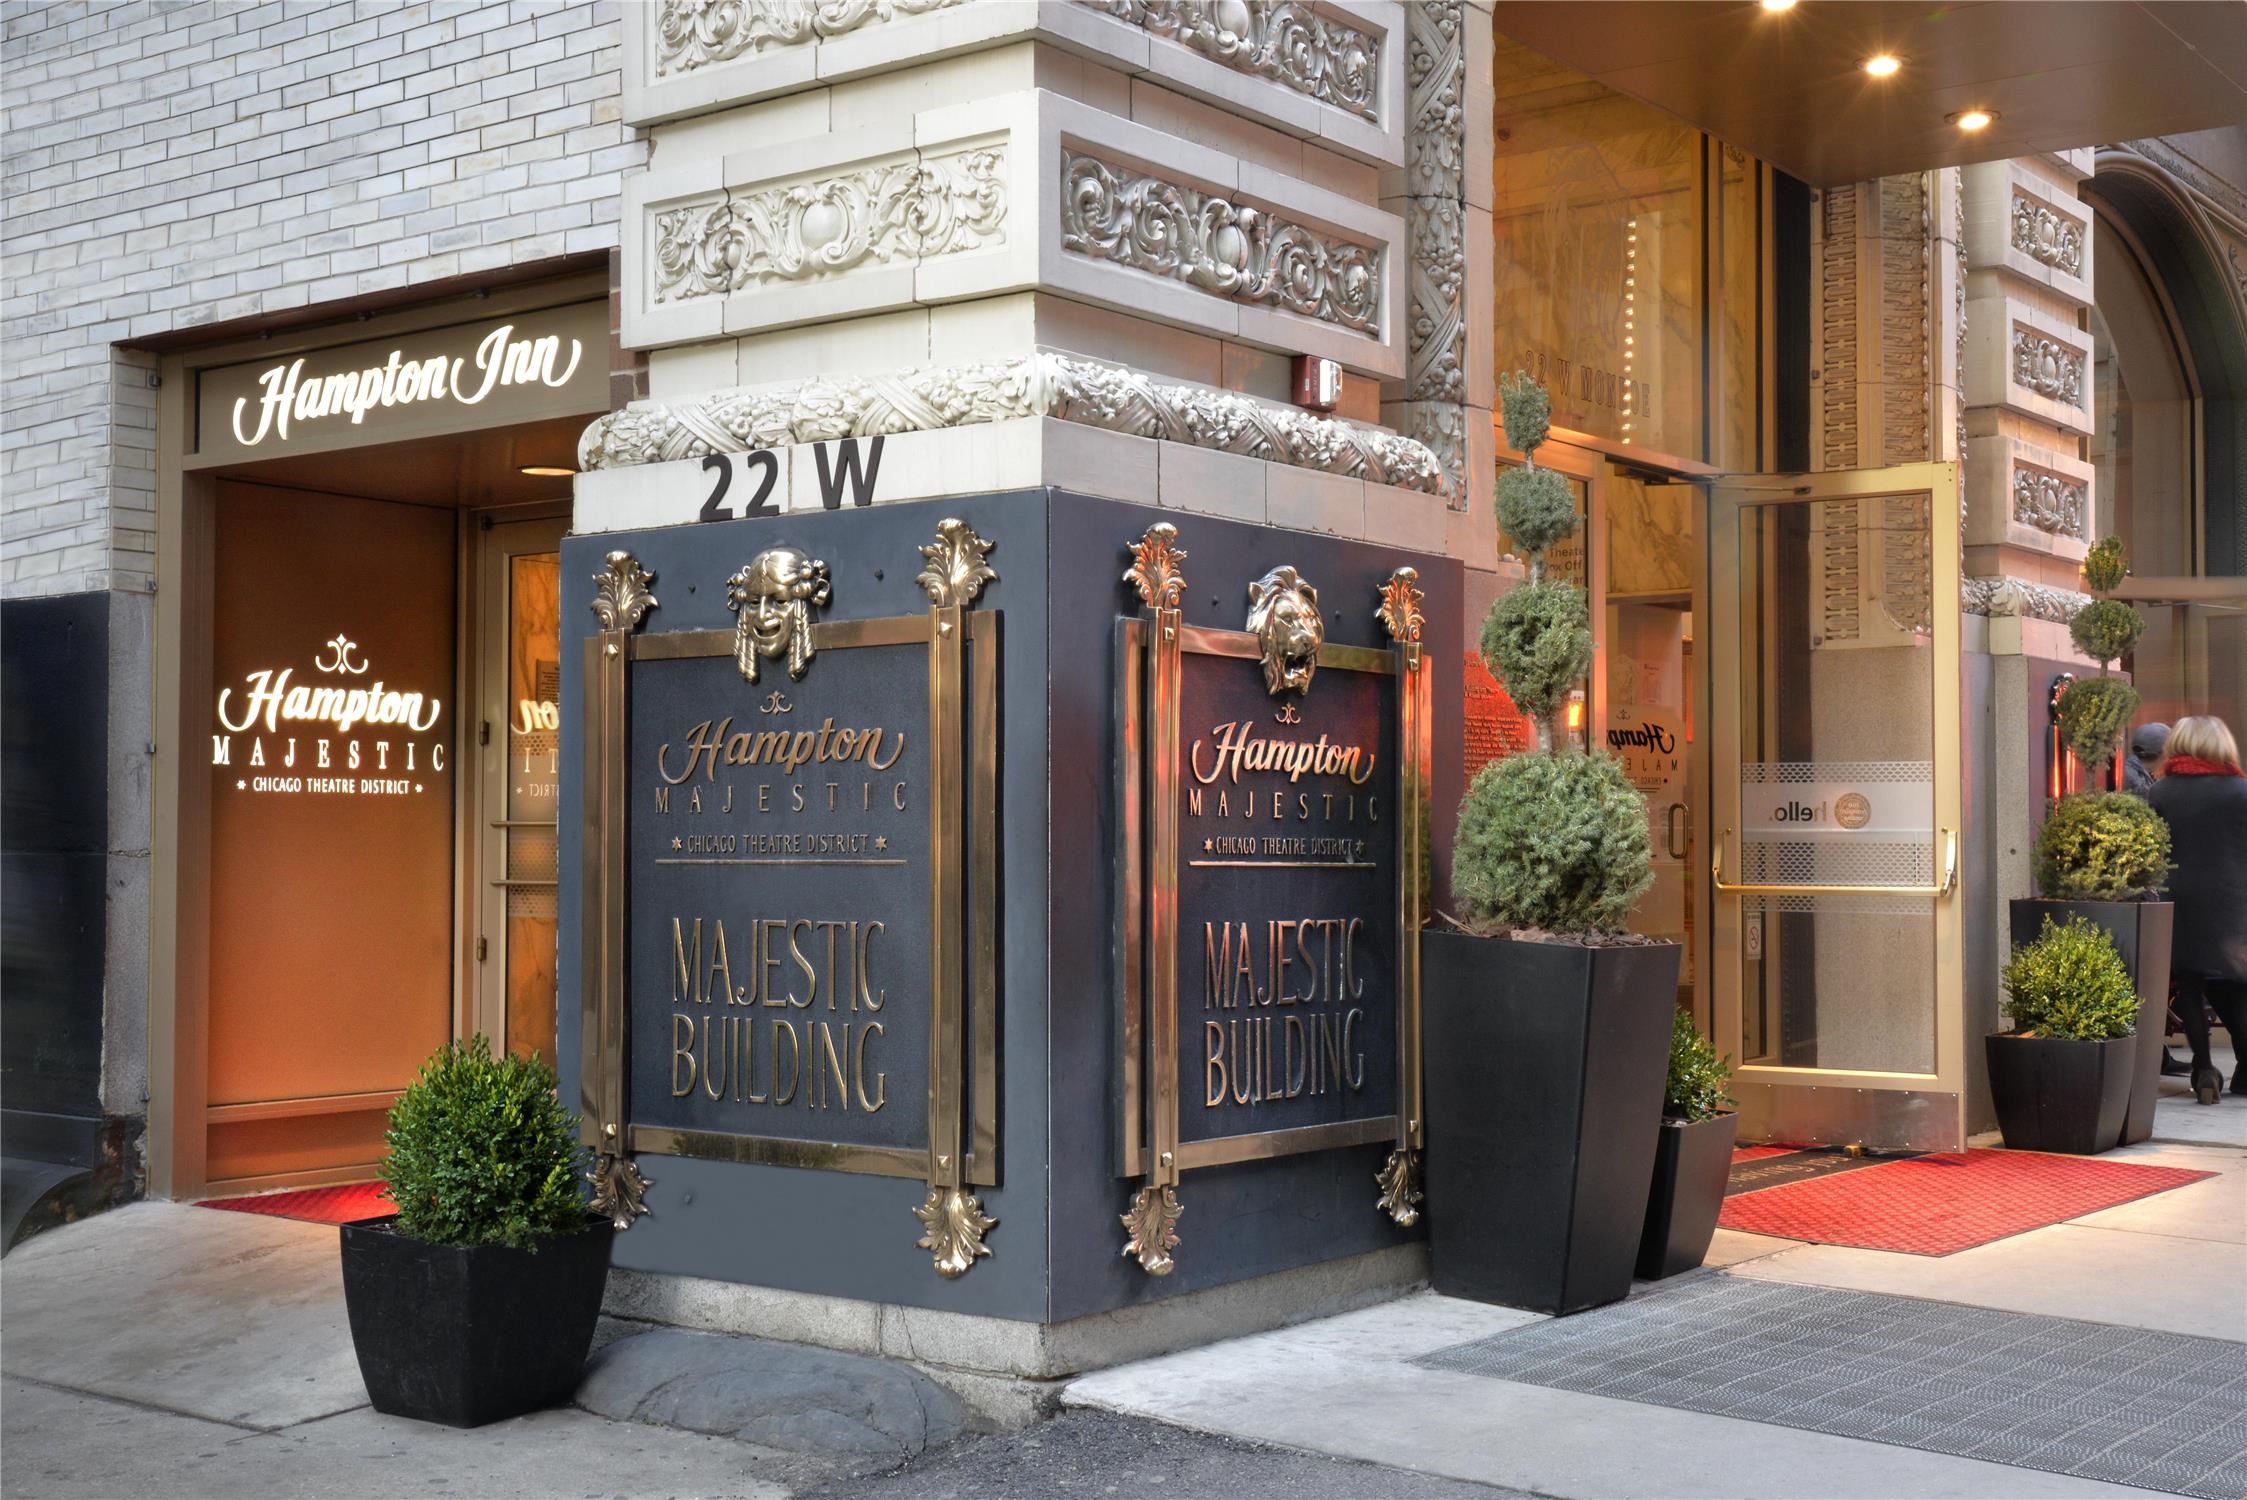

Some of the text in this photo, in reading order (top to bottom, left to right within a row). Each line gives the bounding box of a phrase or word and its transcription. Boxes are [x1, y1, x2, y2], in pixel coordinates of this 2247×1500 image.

[232, 324, 582, 446] Hampton Inn
[1557, 358, 1571, 396] W
[1580, 365, 1650, 418] MONROE
[699, 434, 886, 523] 22 W
[218, 667, 440, 733] Hampton
[212, 735, 445, 772] MAJESTIC
[658, 716, 905, 786] Hampton
[1191, 719, 1375, 785] Hampton
[253, 776, 410, 795] CHICAGO THEATRE DISTRICT
[655, 781, 907, 814] MAJESTIC
[1189, 788, 1378, 822] MAJESTIC
[687, 833, 869, 854] CHICAGO THEATRE DISTRICT
[1216, 836, 1353, 856] CHICAGO THEATRE DISTRICT
[672, 916, 886, 1012] MAJESTIC
[1205, 917, 1364, 1009] MAJESTIC
[672, 1013, 885, 1112] BUILDING
[1205, 1008, 1365, 1107] BUILDING
